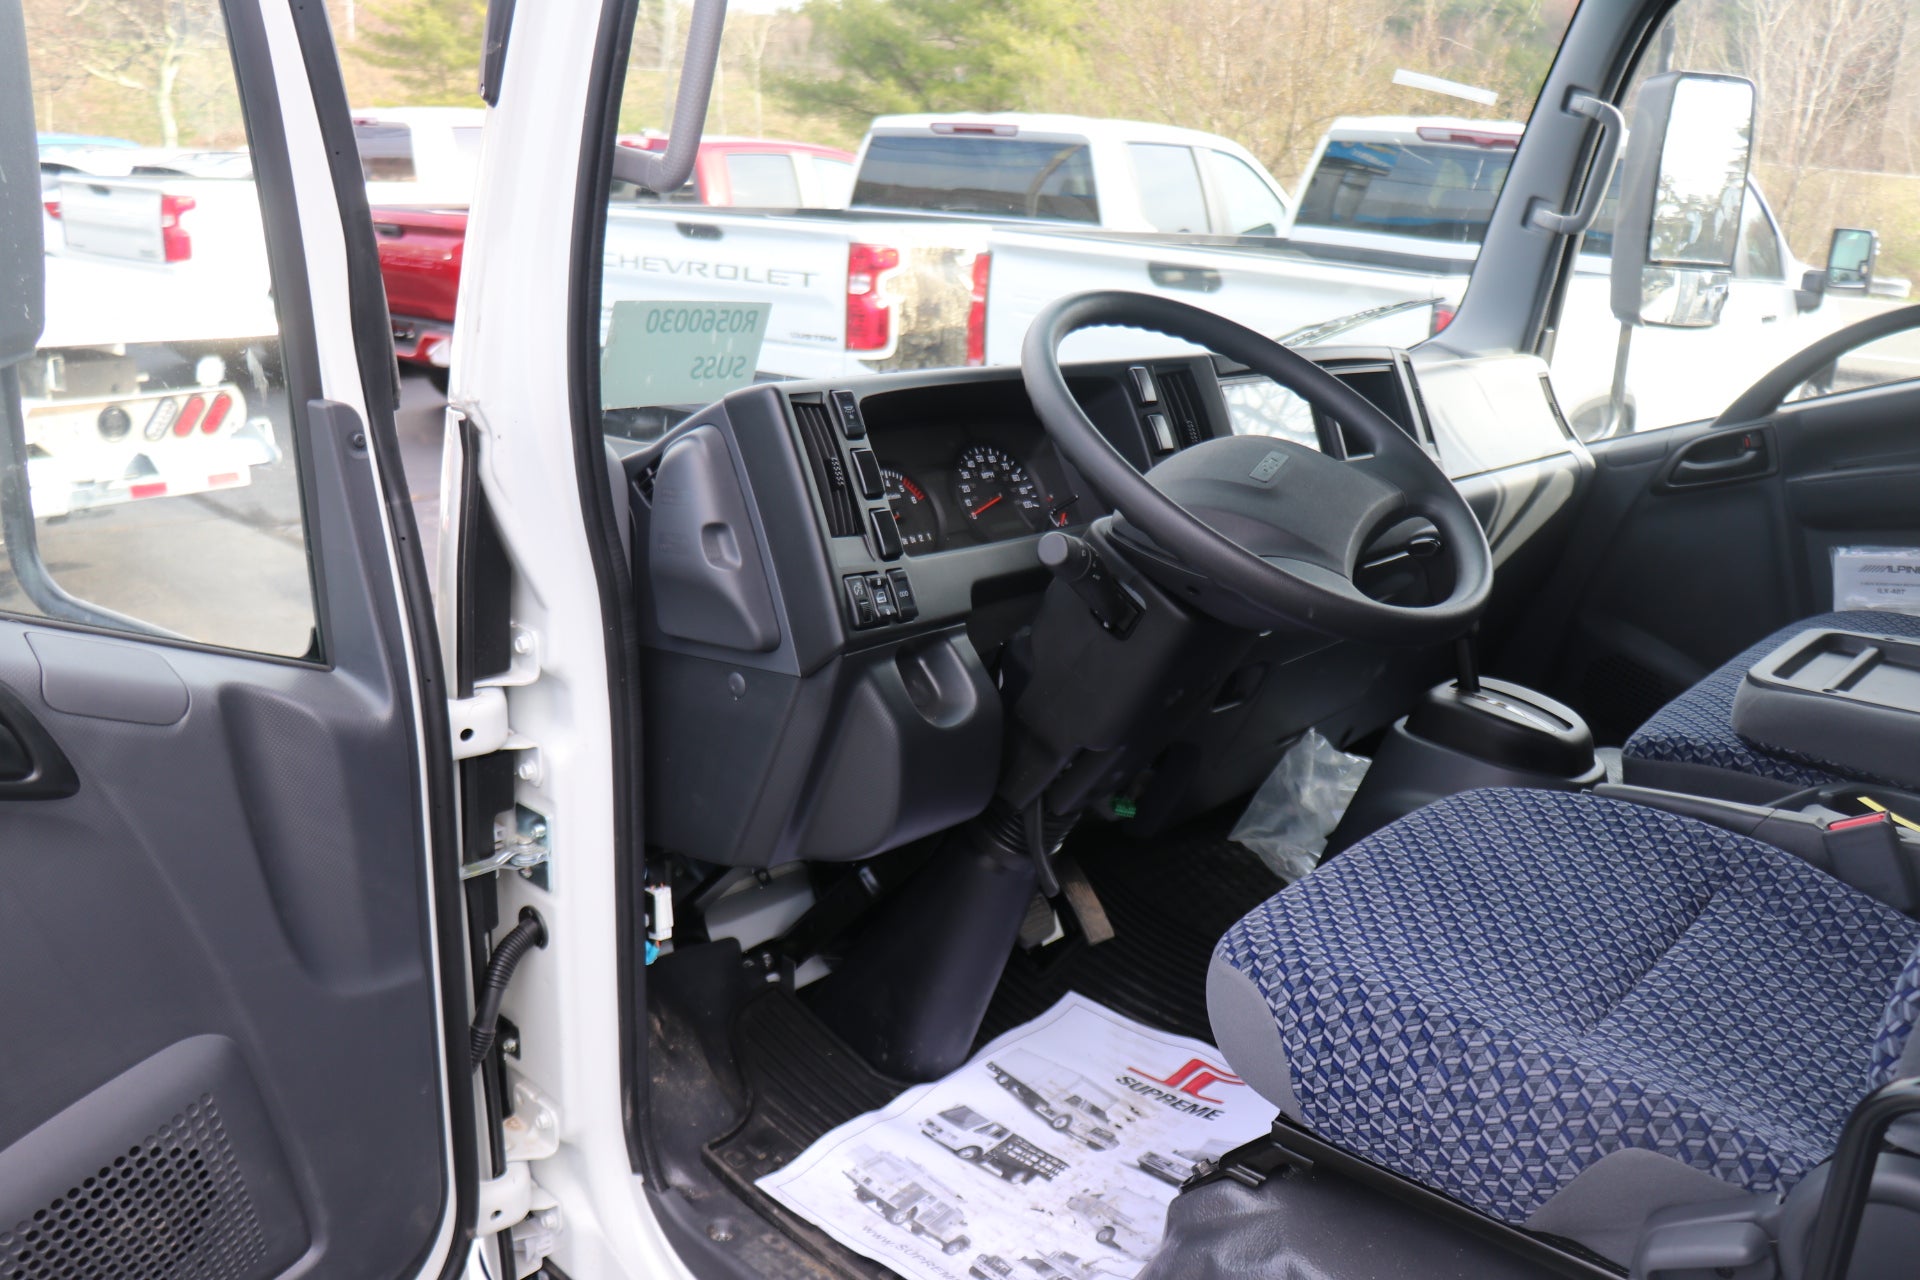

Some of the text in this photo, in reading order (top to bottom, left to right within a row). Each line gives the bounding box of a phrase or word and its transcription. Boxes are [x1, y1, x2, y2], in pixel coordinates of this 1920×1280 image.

[789, 332, 838, 342] CUSTOM
[976, 455, 985, 463] 50
[988, 455, 997, 463] 60
[967, 460, 976, 468] 40
[1001, 463, 1010, 471] 70
[961, 471, 971, 480] 30
[981, 472, 995, 480] MPH
[899, 484, 905, 493] 5
[961, 485, 971, 493] 20
[911, 496, 917, 504] 6
[964, 499, 972, 507] 10
[1023, 500, 1033, 509] 100
[1116, 1076, 1225, 1121] SUPREME
